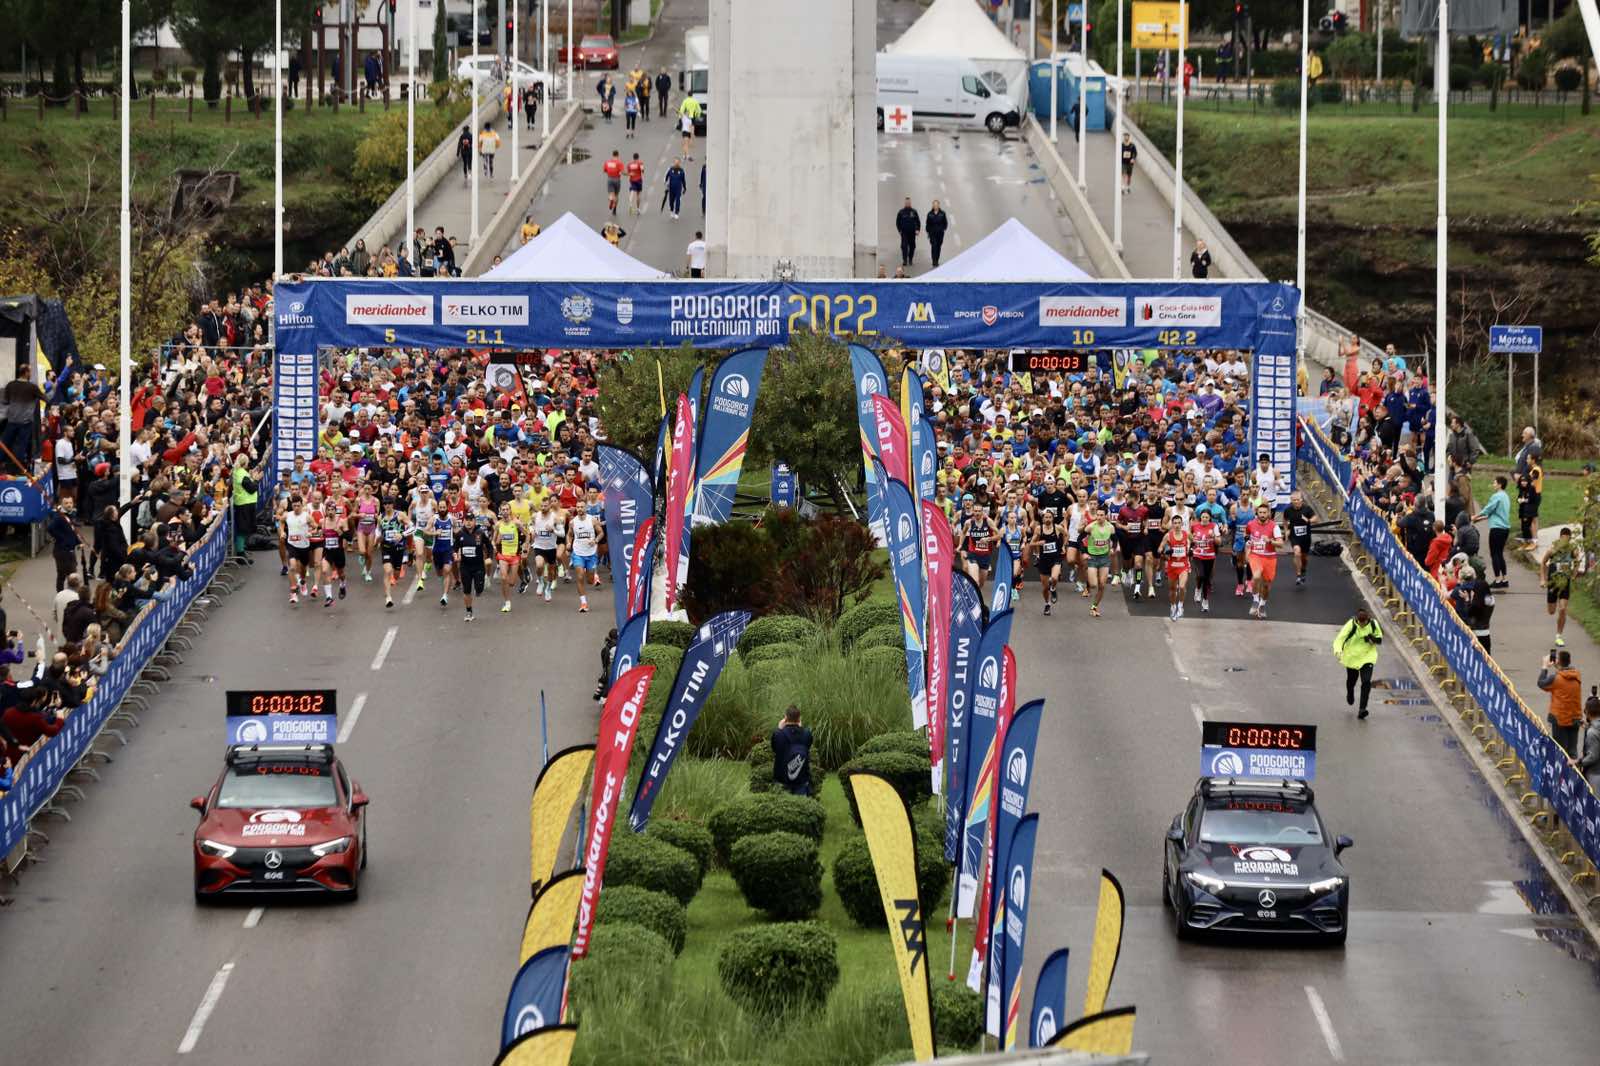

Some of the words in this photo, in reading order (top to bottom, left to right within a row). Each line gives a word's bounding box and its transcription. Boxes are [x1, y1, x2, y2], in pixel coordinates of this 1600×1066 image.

[352, 303, 427, 318] meridianbet
[461, 305, 497, 316] ELKO
[502, 305, 523, 316] TIM
[671, 295, 781, 319] PODGORICA
[1046, 304, 1120, 318] meridianbet
[279, 313, 314, 324] Hilton
[788, 294, 880, 336] 2022
[954, 311, 980, 319] SPORT
[998, 311, 1024, 319] VISION
[671, 319, 752, 336] MILLENNIUM
[756, 319, 780, 336] RUN
[384, 328, 396, 343] 5
[466, 328, 505, 344] 21.1
[1072, 330, 1095, 345] 10
[1158, 330, 1197, 345] 42.2
[1030, 356, 1080, 369] 0:00:03
[714, 396, 750, 412] PODGORICA
[681, 660, 710, 709] TIM
[251, 695, 325, 713] 0:00:02
[614, 673, 648, 753] 10km
[272, 720, 328, 733] PODGORICA
[1228, 727, 1303, 748] 0:00:02
[1250, 753, 1305, 768] PODGORICA
